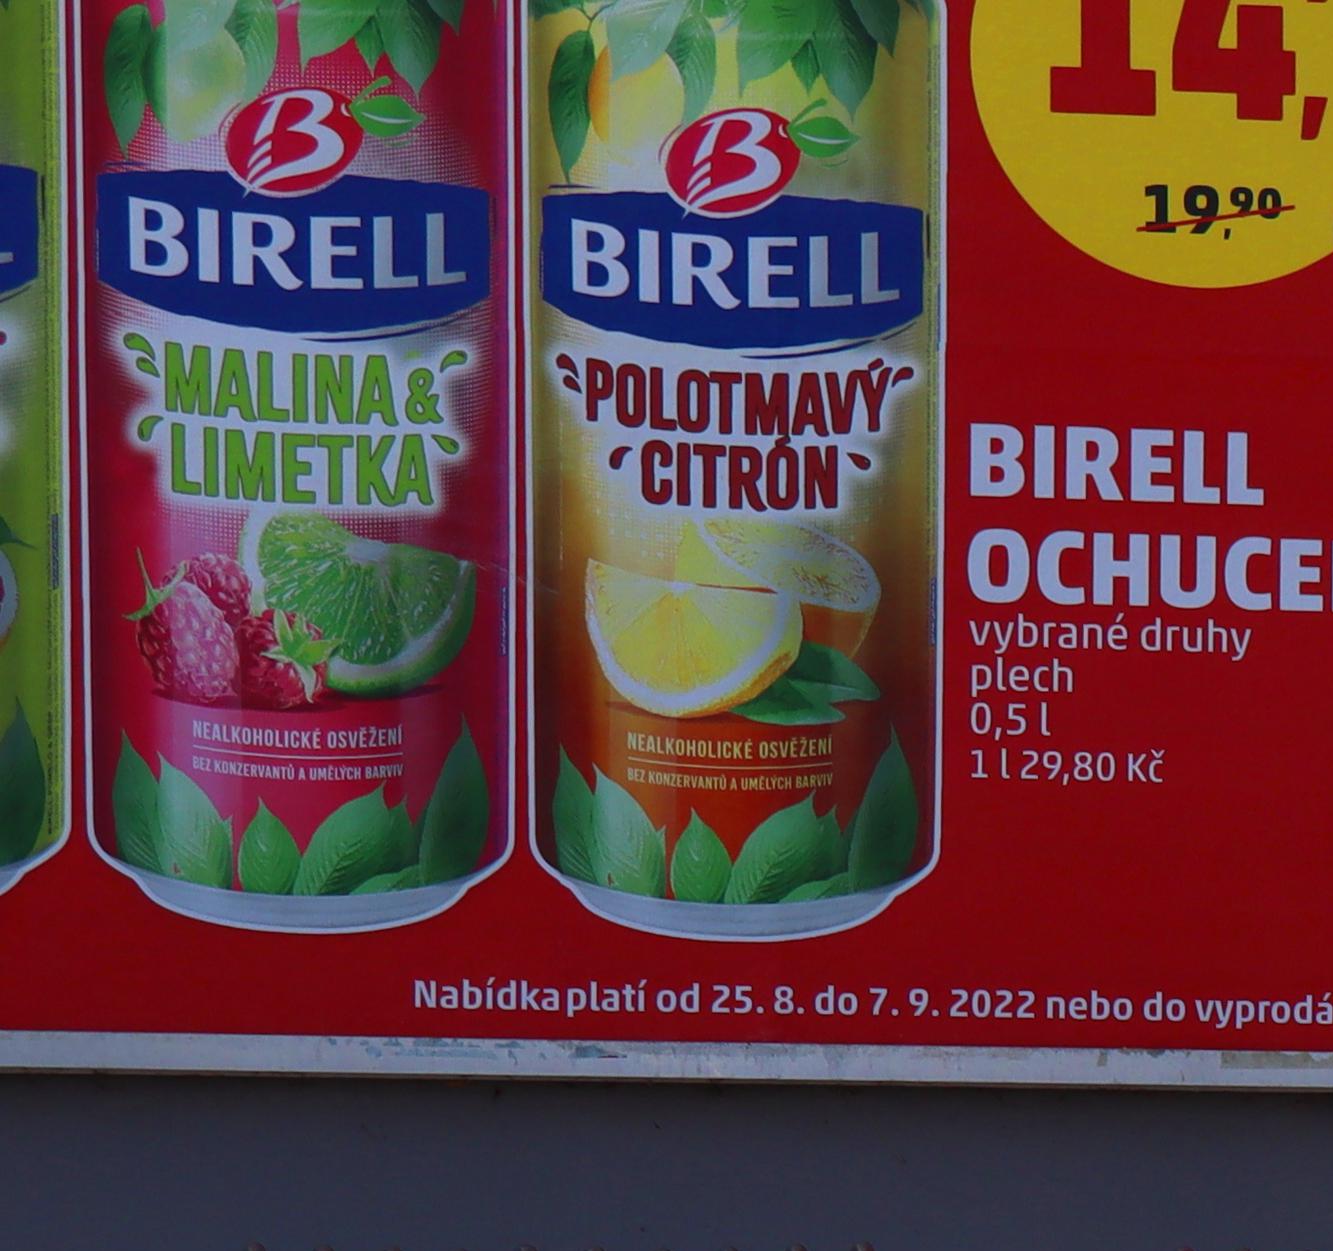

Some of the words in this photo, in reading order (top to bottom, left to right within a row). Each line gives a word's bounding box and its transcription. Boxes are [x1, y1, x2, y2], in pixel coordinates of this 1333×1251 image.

[1144, 184, 1282, 240] 19,90
[127, 195, 468, 291] BIRELL
[569, 217, 901, 311] BIRELL
[164, 341, 397, 426] MALINA
[404, 367, 444, 425] &
[585, 357, 893, 438] POLOTMAVÝ
[170, 423, 434, 507] LIMETKA
[640, 435, 839, 512] CITRÓN
[969, 422, 1265, 506] BIRELL
[969, 612, 1129, 655] vybrané
[1140, 617, 1252, 661] druhy
[970, 656, 1074, 698] plech
[192, 719, 322, 749] NEALKOHOLICKÉ
[327, 724, 403, 749] OSVĚŽENÍ
[627, 731, 753, 760] NEALKOHOLICKÉ
[759, 734, 833, 758] OSVĚŽENÍ
[970, 702, 1028, 741] 0,5
[192, 756, 213, 773] BEZ
[214, 761, 296, 781] KONZERVANTŮ
[627, 767, 646, 783] BEZ
[648, 771, 727, 791] KONZERVANTŮ
[1020, 750, 1116, 786] 29,80
[1127, 749, 1165, 783] Kč
[656, 982, 700, 1014] od
[814, 985, 858, 1016] do
[949, 989, 1035, 1019] 2022
[1046, 990, 1133, 1021] nebo
[1143, 991, 1186, 1022] do
